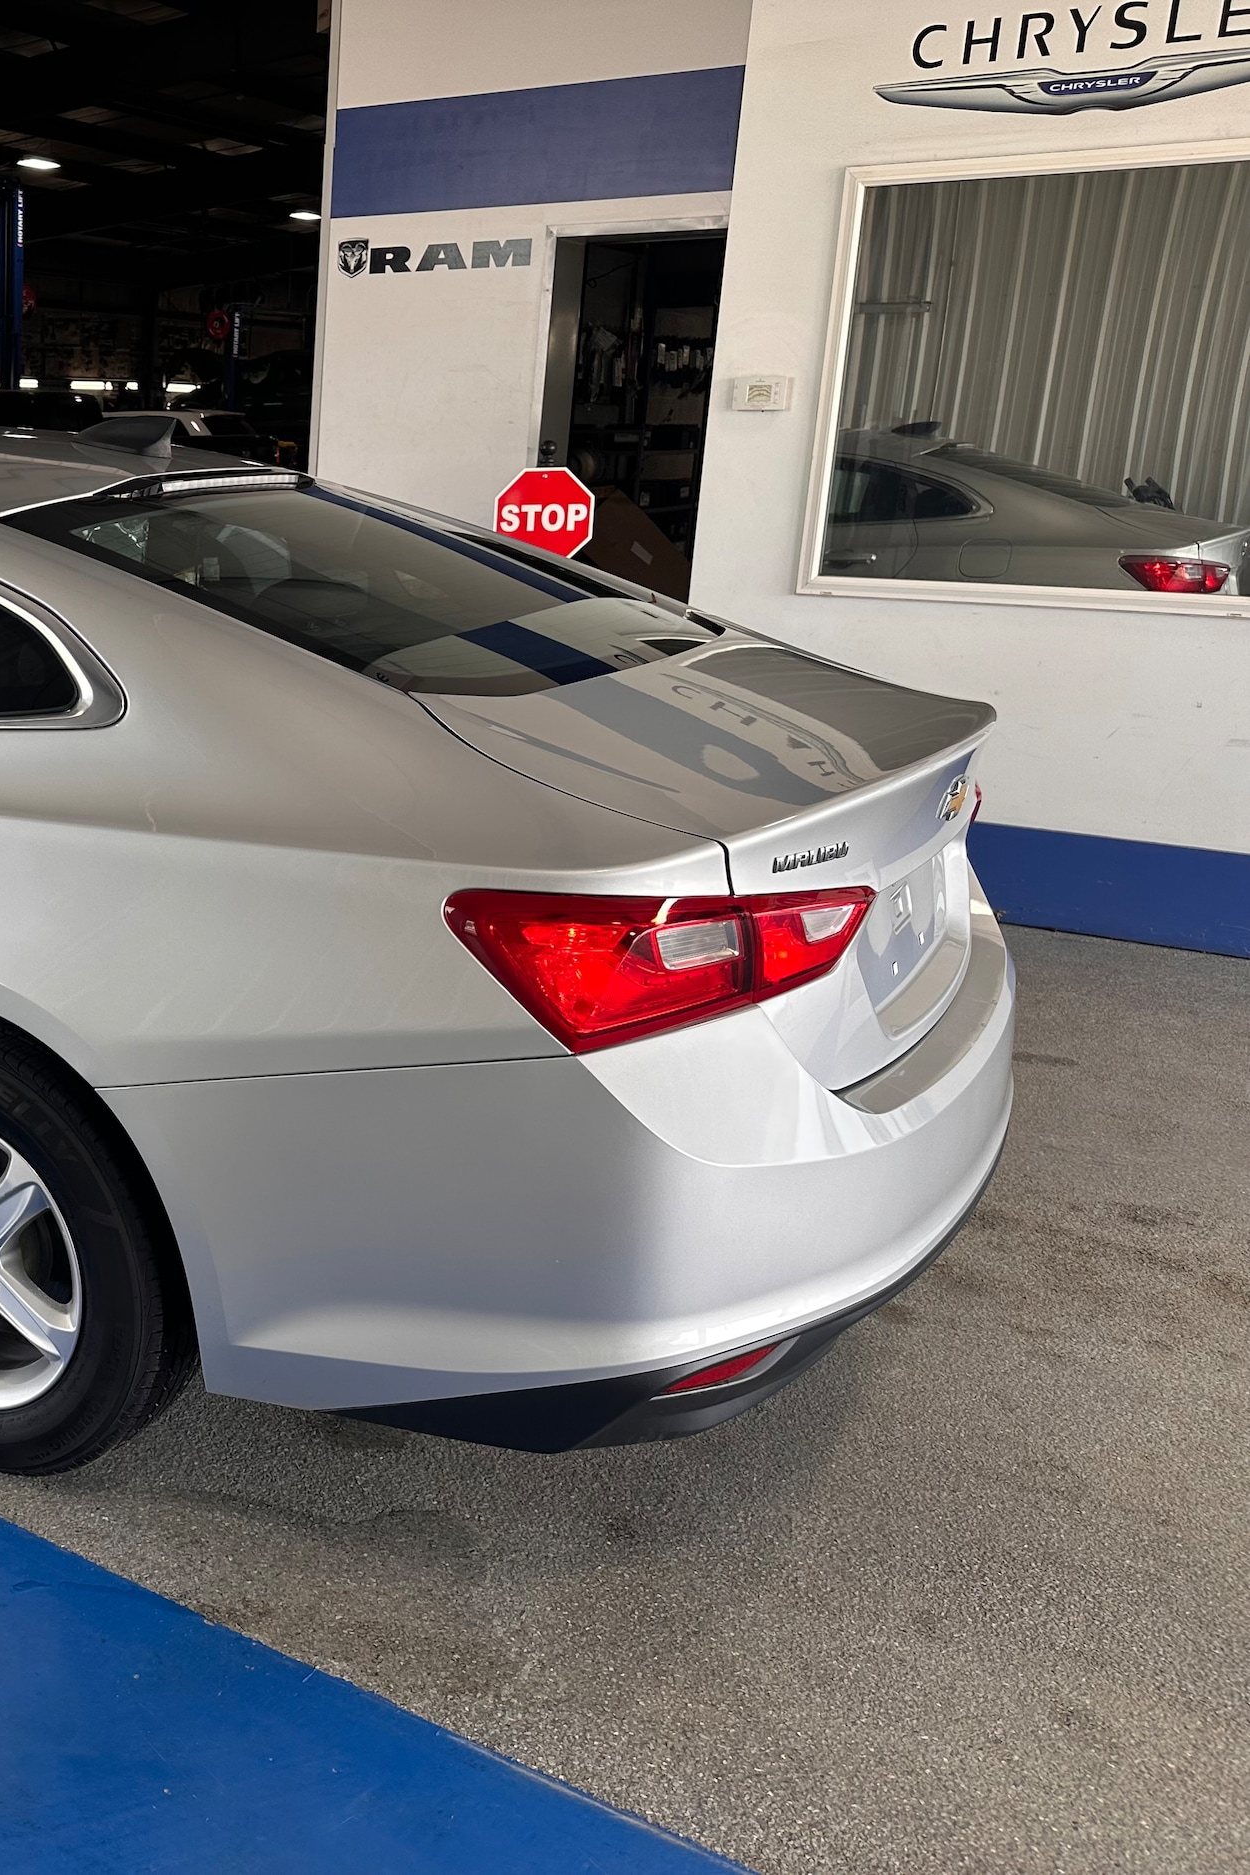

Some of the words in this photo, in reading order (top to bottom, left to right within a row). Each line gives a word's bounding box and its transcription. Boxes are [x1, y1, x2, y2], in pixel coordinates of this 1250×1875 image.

[1049, 75, 1142, 93] CHRYSLER
[369, 238, 533, 274] RAM
[500, 503, 588, 532] STOP
[772, 841, 849, 873] MALIBU
